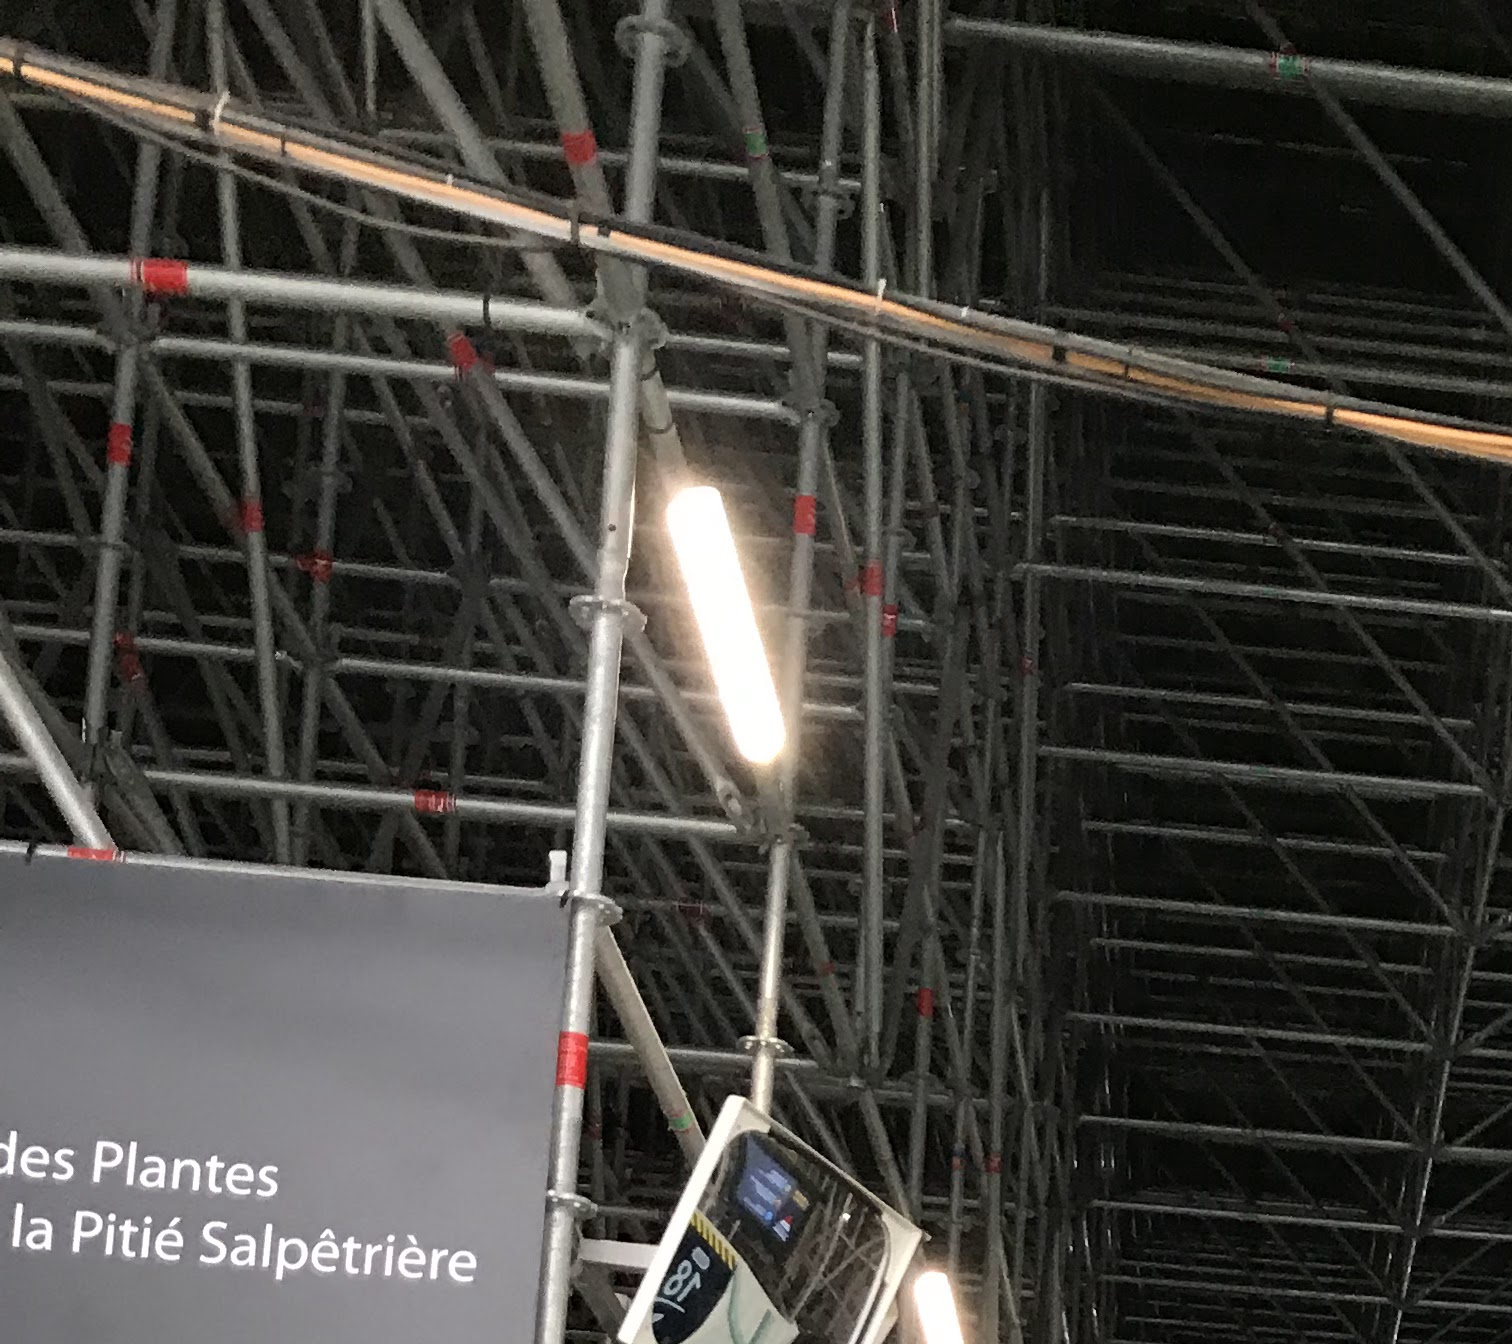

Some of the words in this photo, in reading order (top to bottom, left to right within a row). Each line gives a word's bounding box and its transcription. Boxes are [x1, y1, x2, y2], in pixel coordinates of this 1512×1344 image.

[0, 1130, 74, 1180] des
[92, 1140, 280, 1198] Plantes
[12, 1203, 53, 1251] la
[72, 1210, 184, 1261] Pitié
[199, 1221, 478, 1283] Salpêtrière
